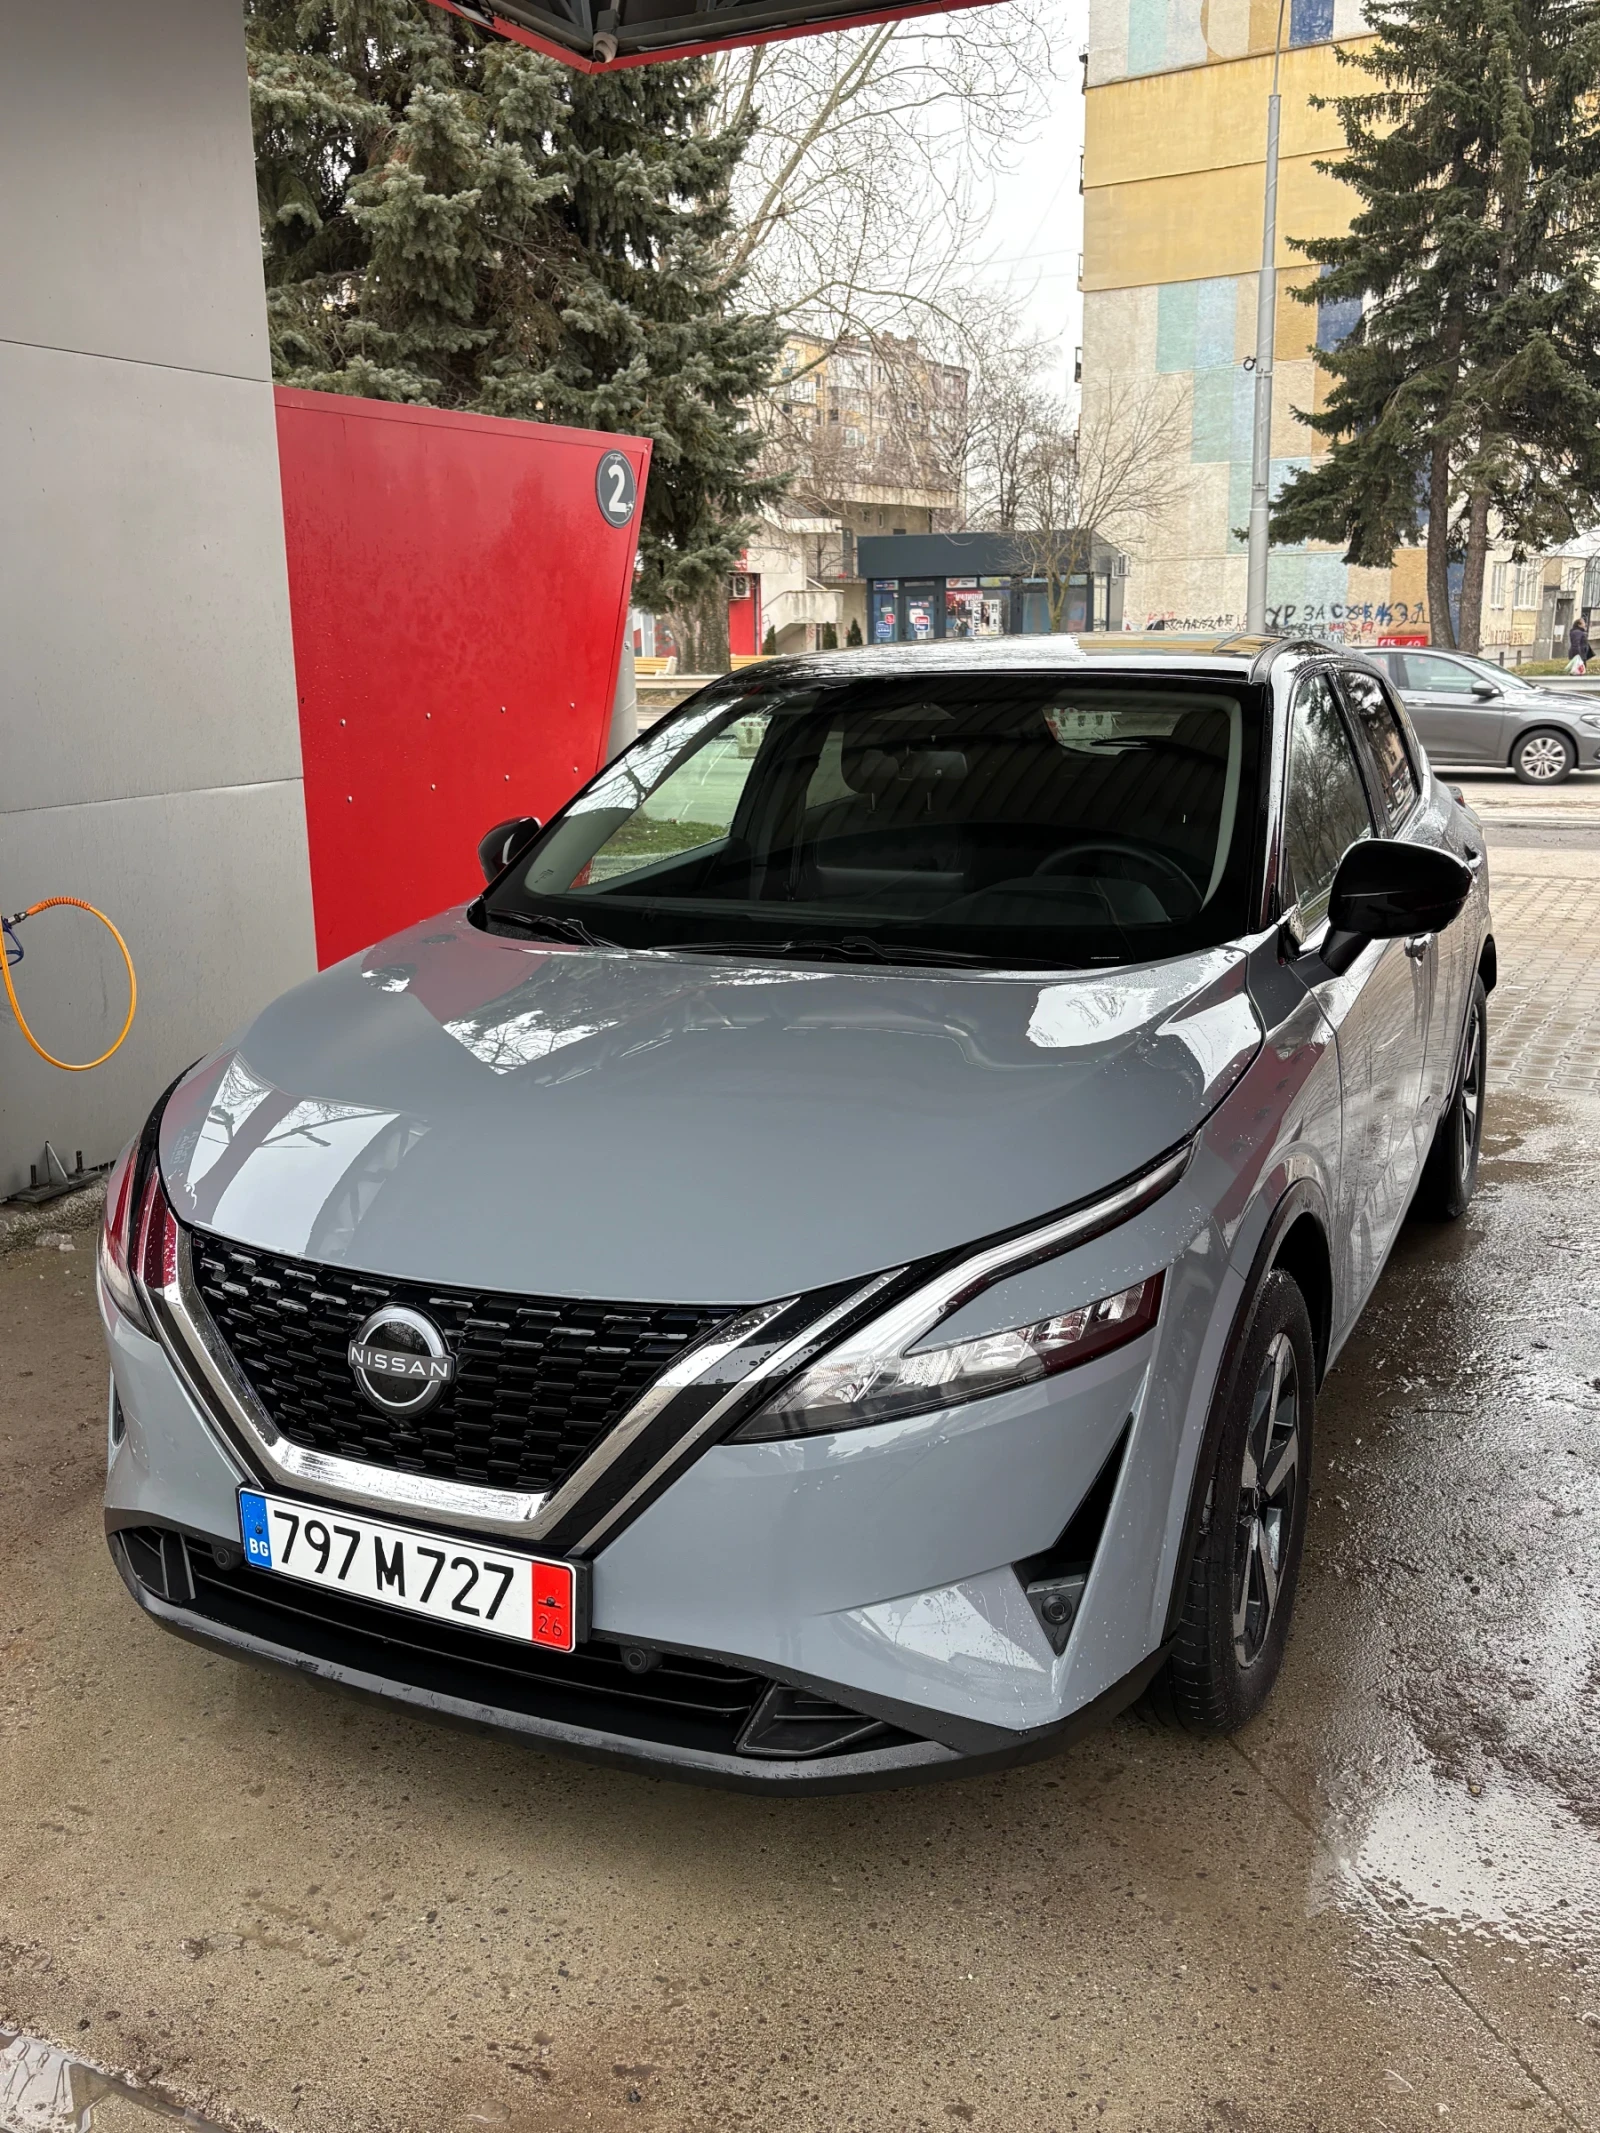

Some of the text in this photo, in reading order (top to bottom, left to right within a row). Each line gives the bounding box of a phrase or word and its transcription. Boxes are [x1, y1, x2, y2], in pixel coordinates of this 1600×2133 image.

[608, 464, 627, 513] 2
[350, 1346, 448, 1378] NISSAN
[249, 1536, 270, 1559] BG
[538, 1613, 563, 1637] 26
